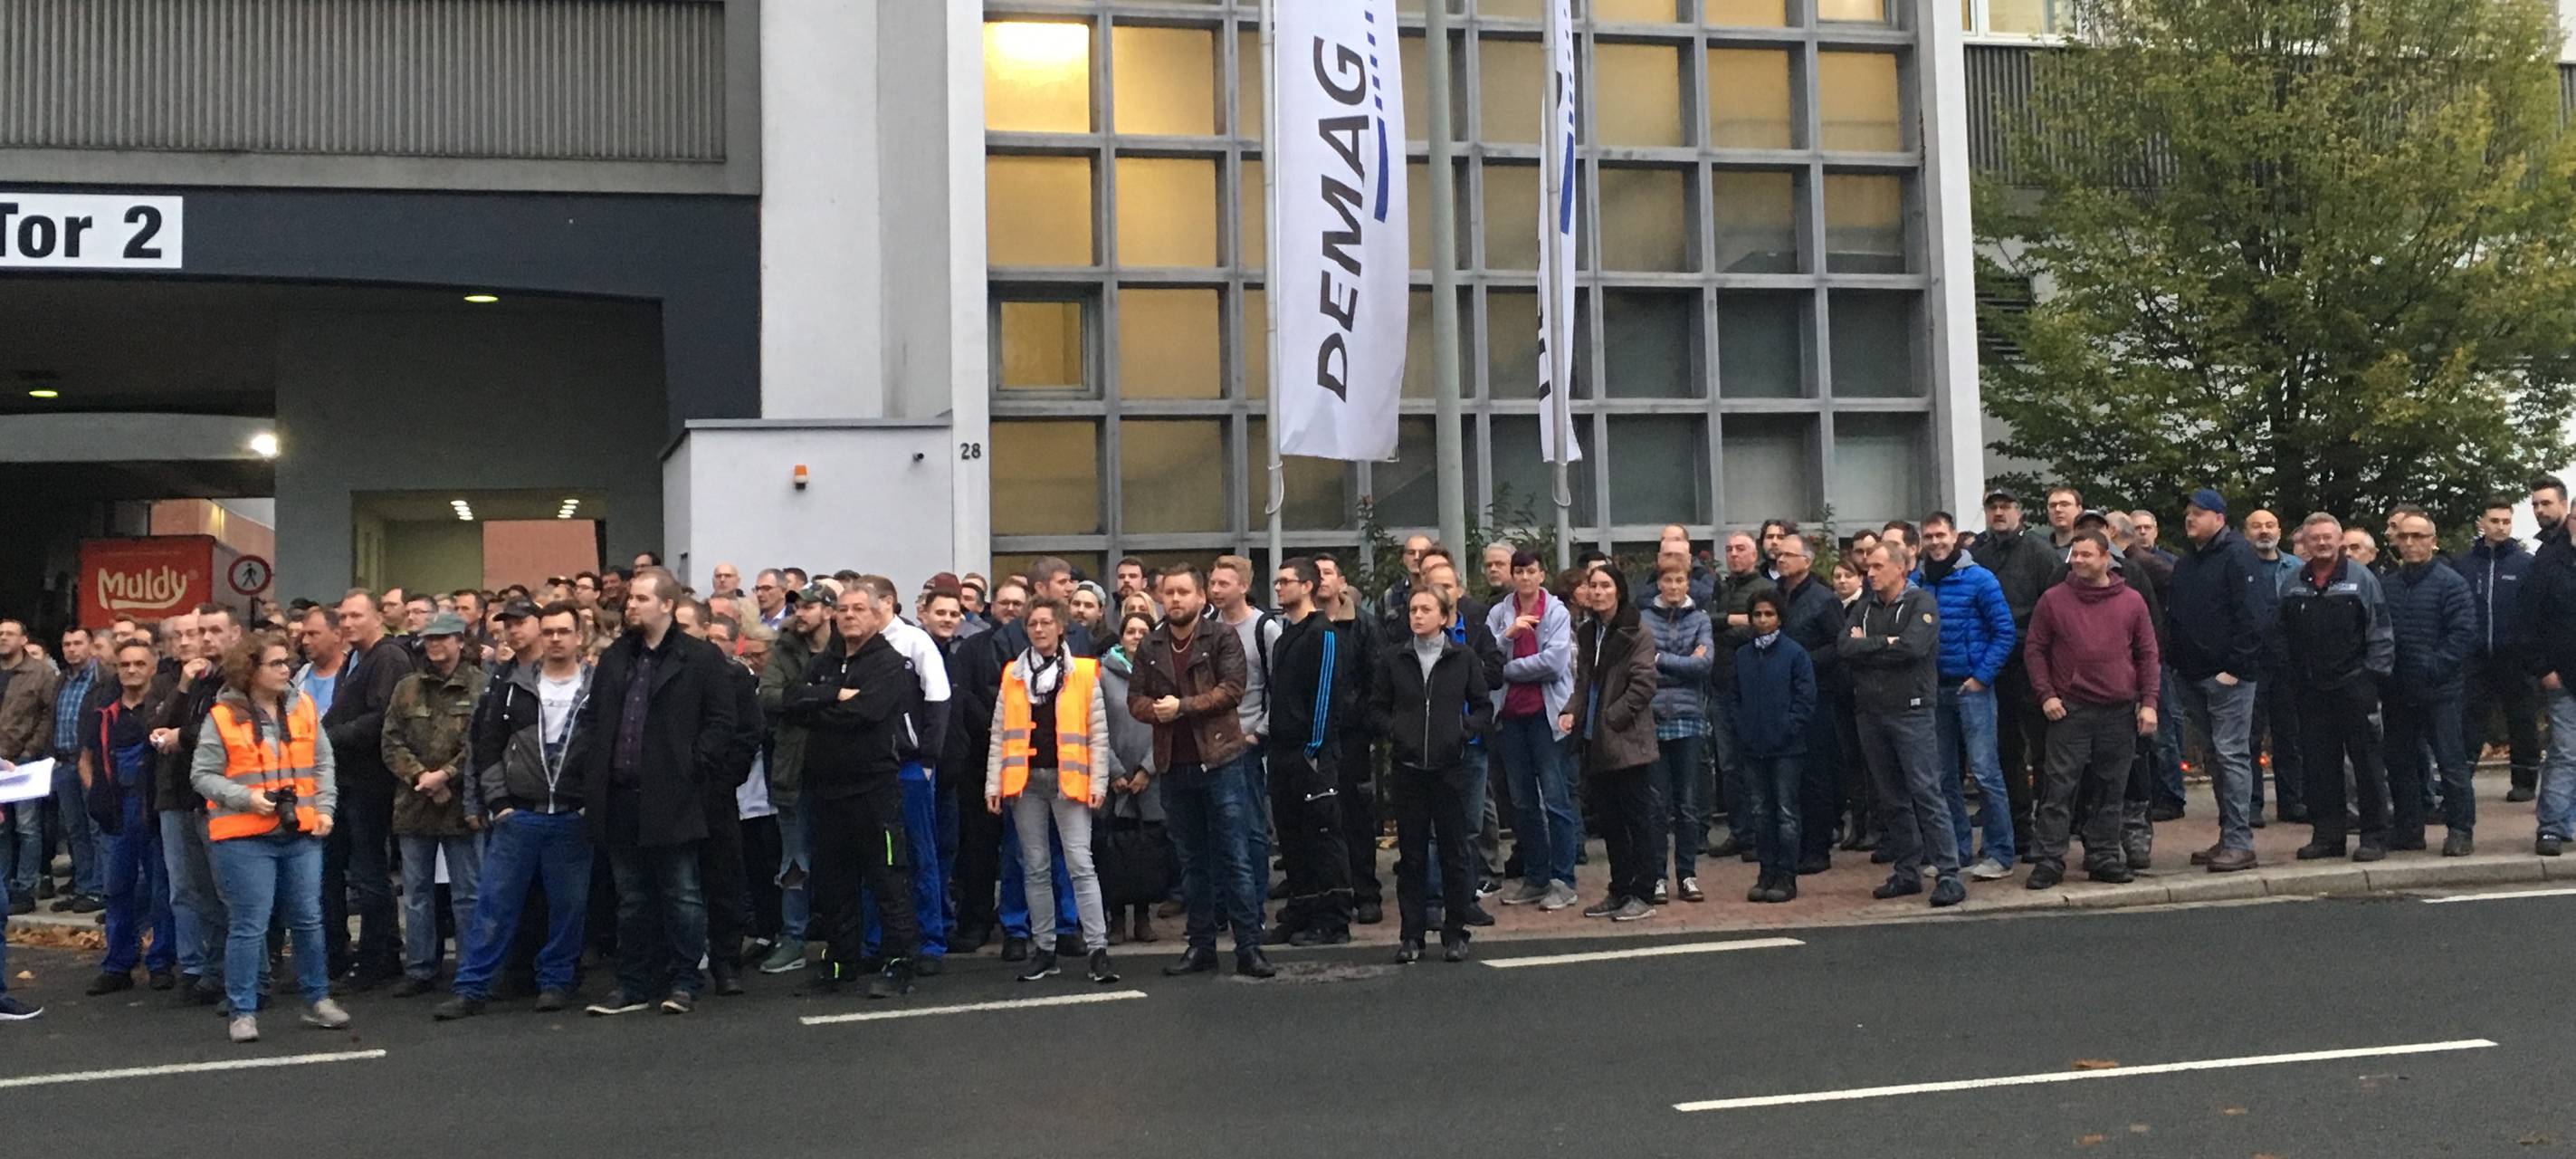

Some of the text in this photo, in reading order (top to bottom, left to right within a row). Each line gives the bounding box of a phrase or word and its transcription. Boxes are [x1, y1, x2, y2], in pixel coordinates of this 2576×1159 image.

[122, 205, 162, 259] 2
[1313, 35, 1369, 403] DEMAG
[959, 442, 981, 460] 28
[98, 565, 187, 610] Muldy
